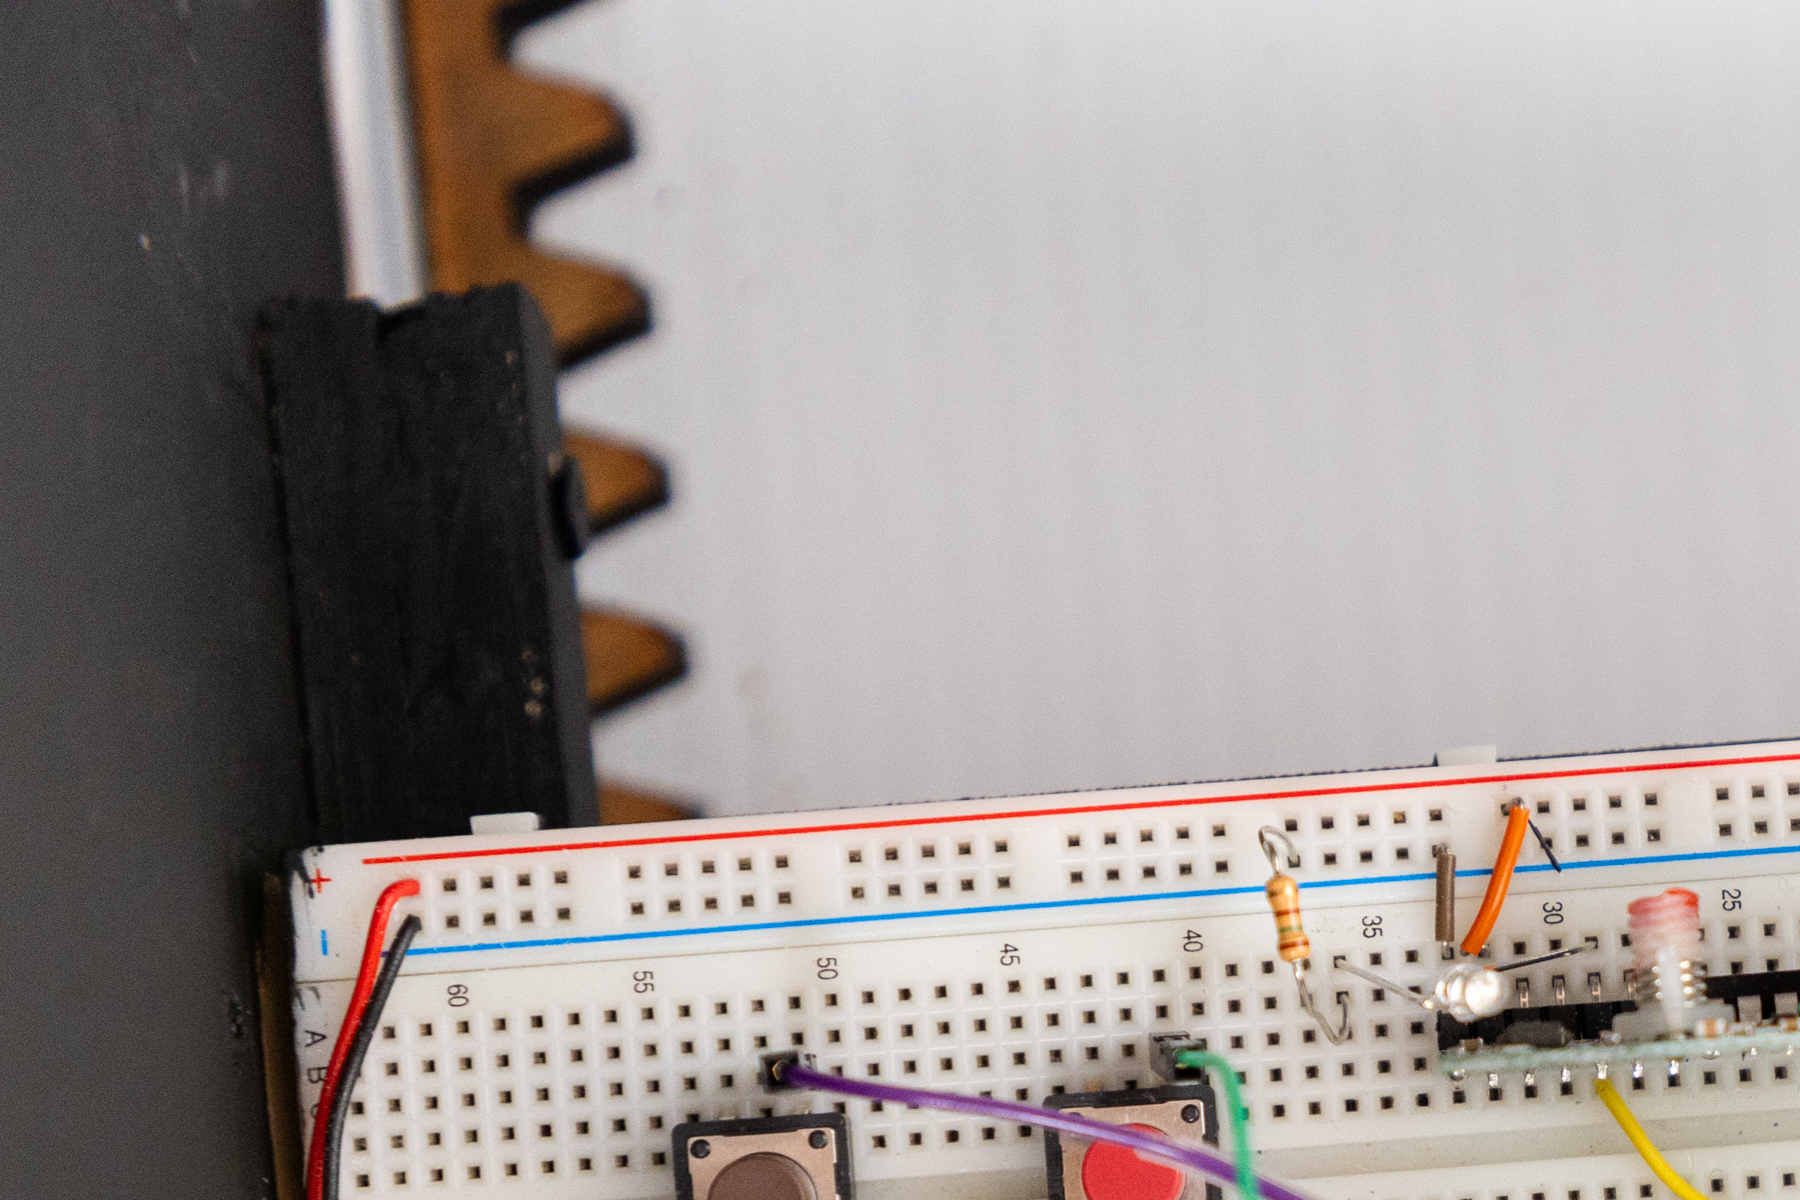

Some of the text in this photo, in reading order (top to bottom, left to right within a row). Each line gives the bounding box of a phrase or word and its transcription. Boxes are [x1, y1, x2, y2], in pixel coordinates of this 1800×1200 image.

[1722, 889, 1741, 911] 25
[1543, 902, 1564, 925] 30
[1362, 916, 1383, 938] 35
[1183, 930, 1203, 952] 40
[1000, 944, 1020, 966] 45
[817, 958, 838, 980] 50
[633, 971, 654, 993] 55
[447, 984, 469, 1007] 60
[304, 1030, 327, 1047] A
